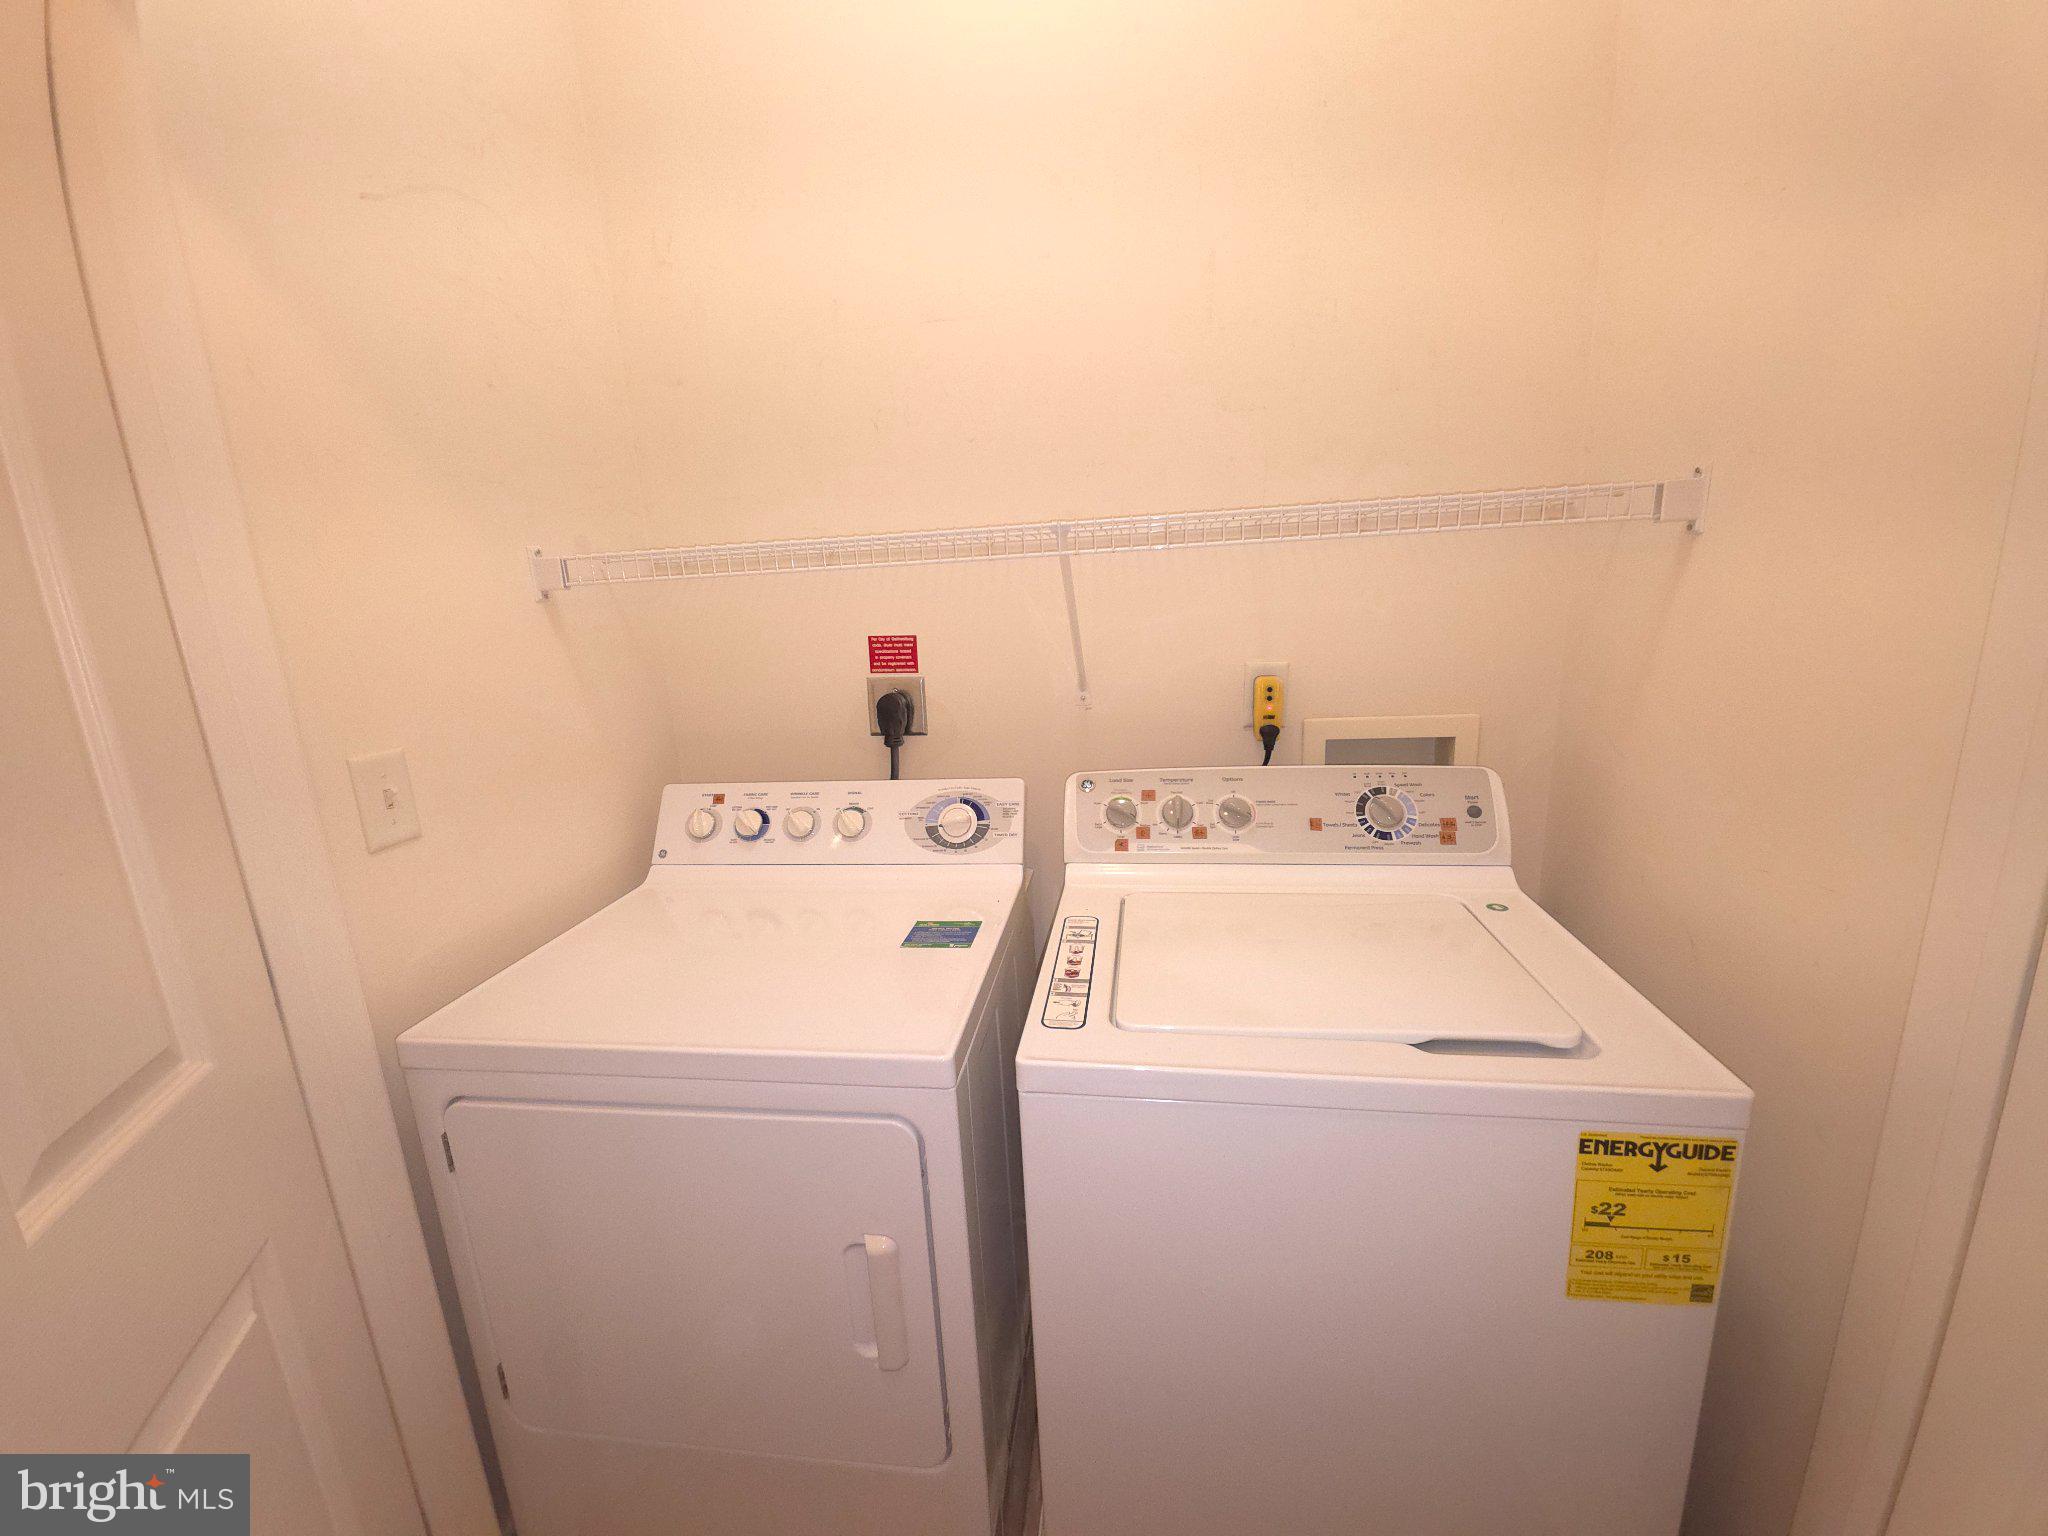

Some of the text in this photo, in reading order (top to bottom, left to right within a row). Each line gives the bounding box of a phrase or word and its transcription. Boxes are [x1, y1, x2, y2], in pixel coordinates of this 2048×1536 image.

[1579, 1138, 1737, 1161] ENERGYGUIDE
[1591, 1202, 1627, 1216] $22
[1585, 1250, 1614, 1259] 208
